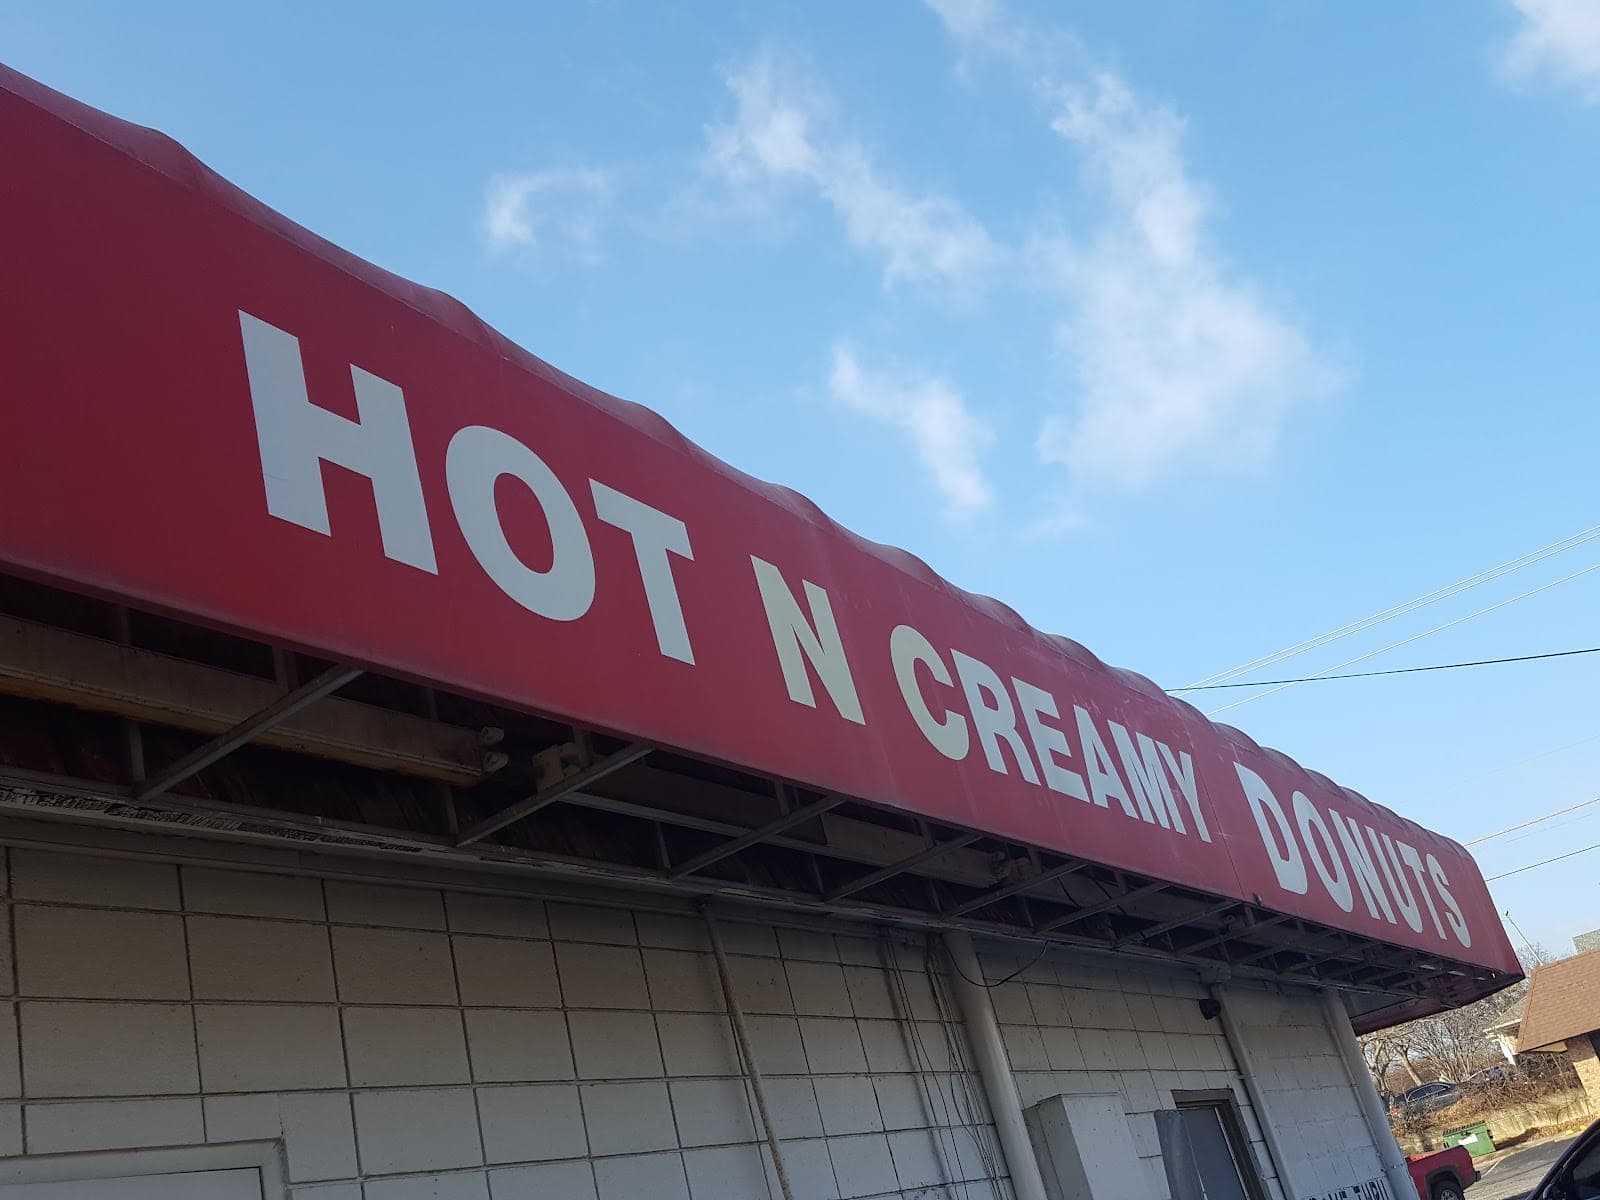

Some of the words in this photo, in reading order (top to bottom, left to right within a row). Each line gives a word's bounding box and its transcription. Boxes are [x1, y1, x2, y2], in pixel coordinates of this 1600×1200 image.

[239, 310, 695, 666] HOT
[750, 555, 866, 725] N
[890, 624, 1212, 843] CREAMY
[1234, 761, 1472, 948] DONUTS
